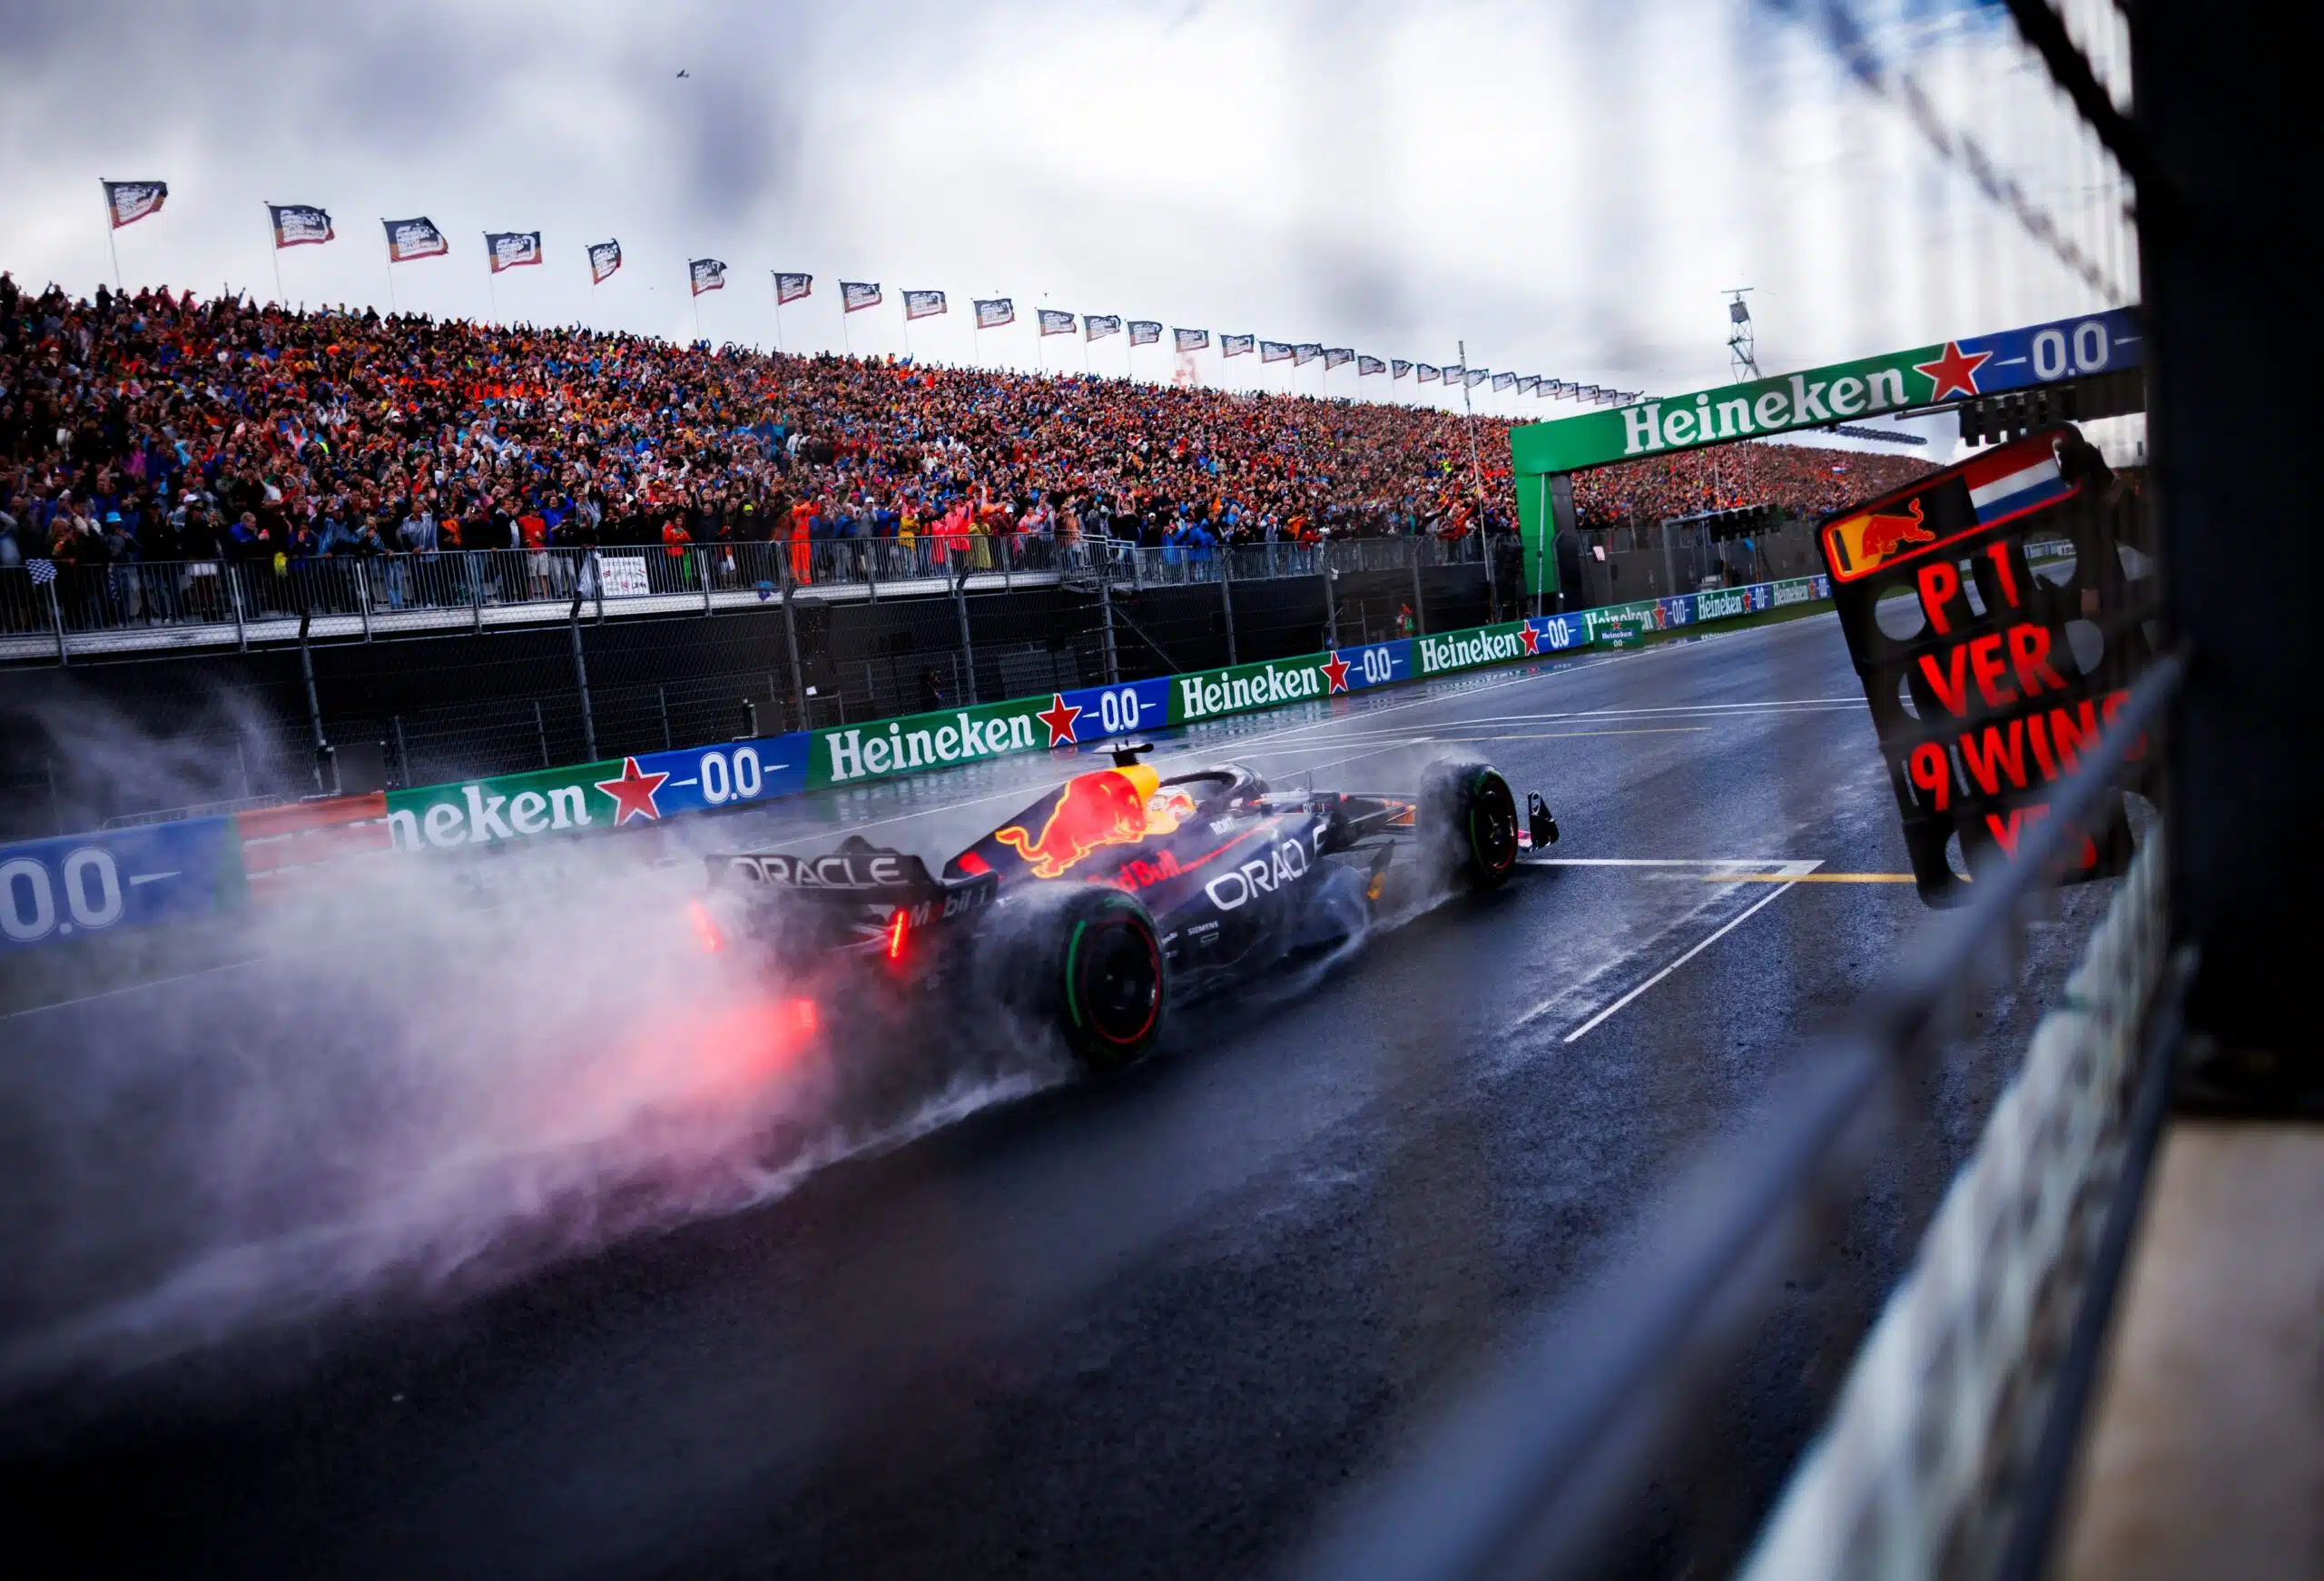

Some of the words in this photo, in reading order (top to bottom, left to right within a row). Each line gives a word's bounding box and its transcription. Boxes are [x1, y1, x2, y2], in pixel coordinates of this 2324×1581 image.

[1620, 367, 1909, 454] Heineken
[2031, 320, 2109, 381] 0.0
[1697, 591, 1742, 620] Heineken
[1773, 581, 1808, 606] Heineken
[1419, 630, 1519, 673] Heineken
[1548, 618, 1571, 648] 0.0
[1601, 630, 1633, 639] Heineken
[1180, 665, 1321, 718] Heineken
[1363, 647, 1392, 683] 0.0
[1918, 623, 2069, 718] VER
[825, 713, 1035, 782] Heineken
[1101, 687, 1139, 733] 0.0
[387, 785, 592, 854] neken
[700, 746, 762, 804] 0.0
[1910, 741, 1949, 812] 9
[0, 846, 124, 942] 0.0
[731, 856, 909, 889] ORACLE
[1206, 823, 1328, 911] ORACLE
[1187, 921, 1219, 936] SIEMENS
